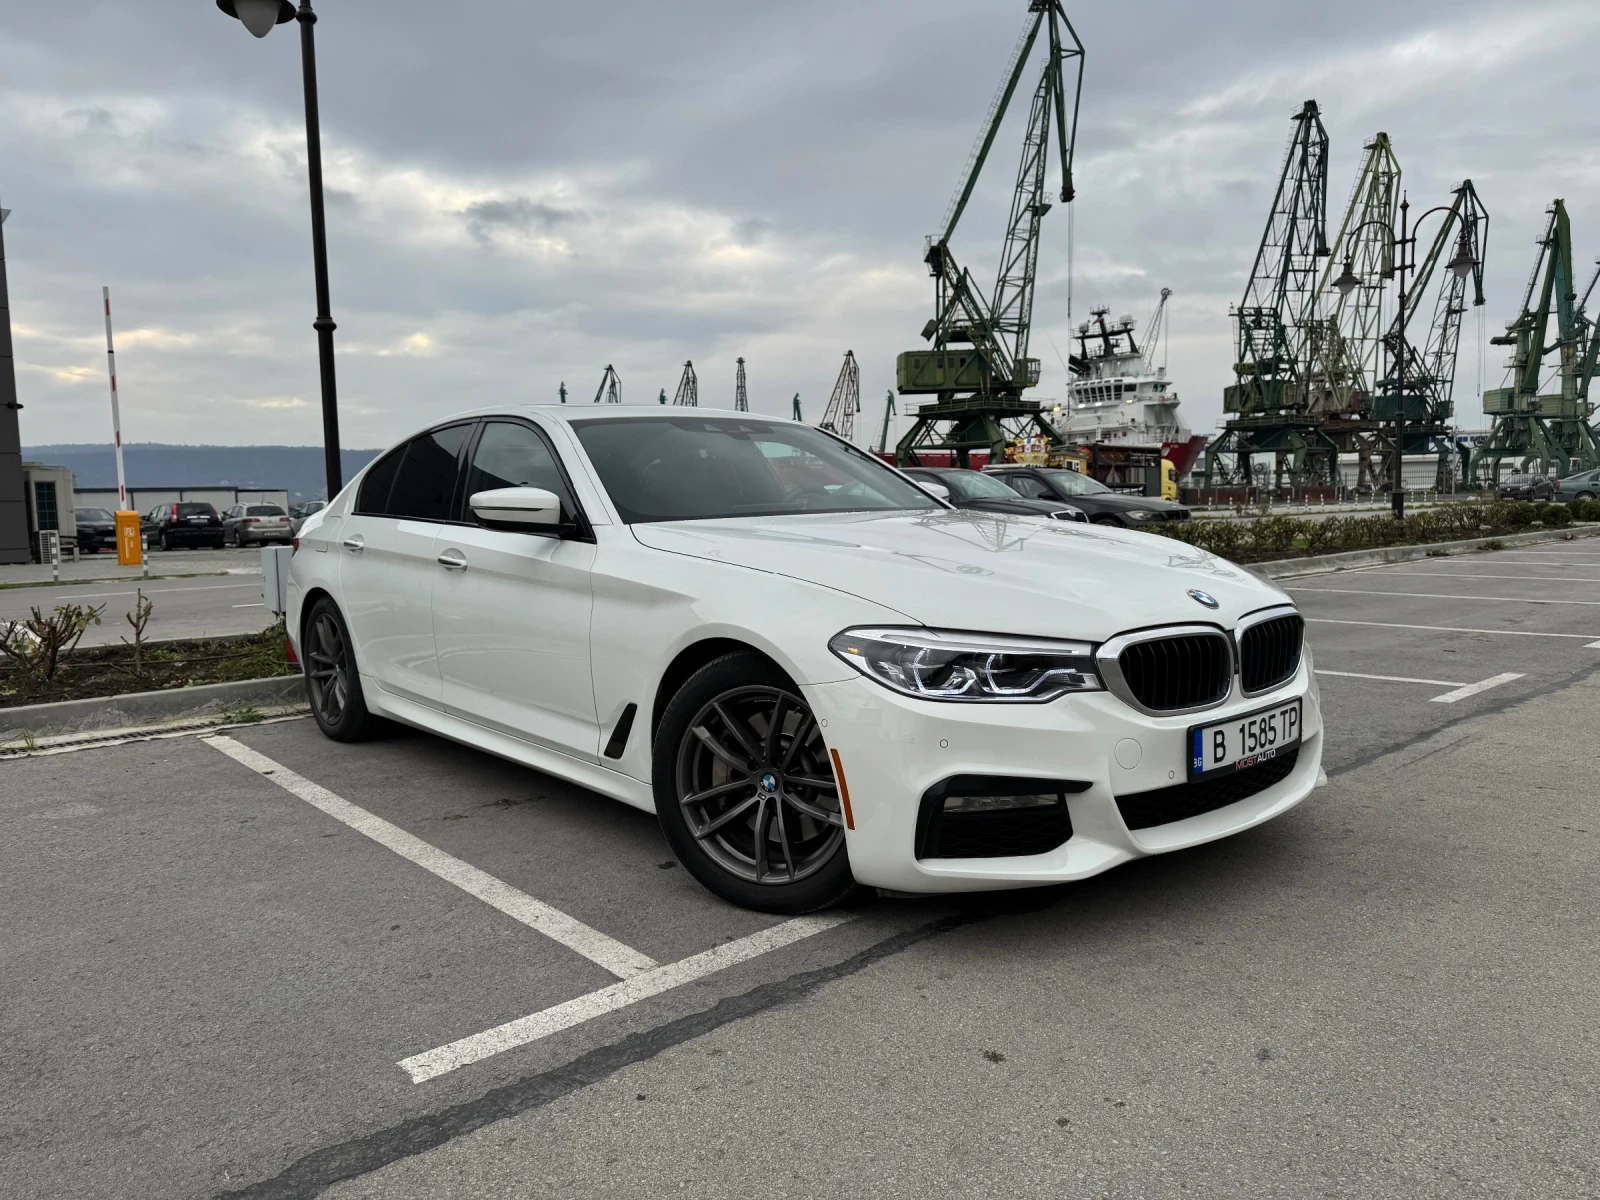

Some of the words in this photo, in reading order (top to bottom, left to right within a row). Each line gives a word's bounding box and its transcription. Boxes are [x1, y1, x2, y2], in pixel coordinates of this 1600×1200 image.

[1213, 729, 1226, 764] B
[1239, 713, 1277, 756] 1585
[1280, 706, 1298, 741] TP
